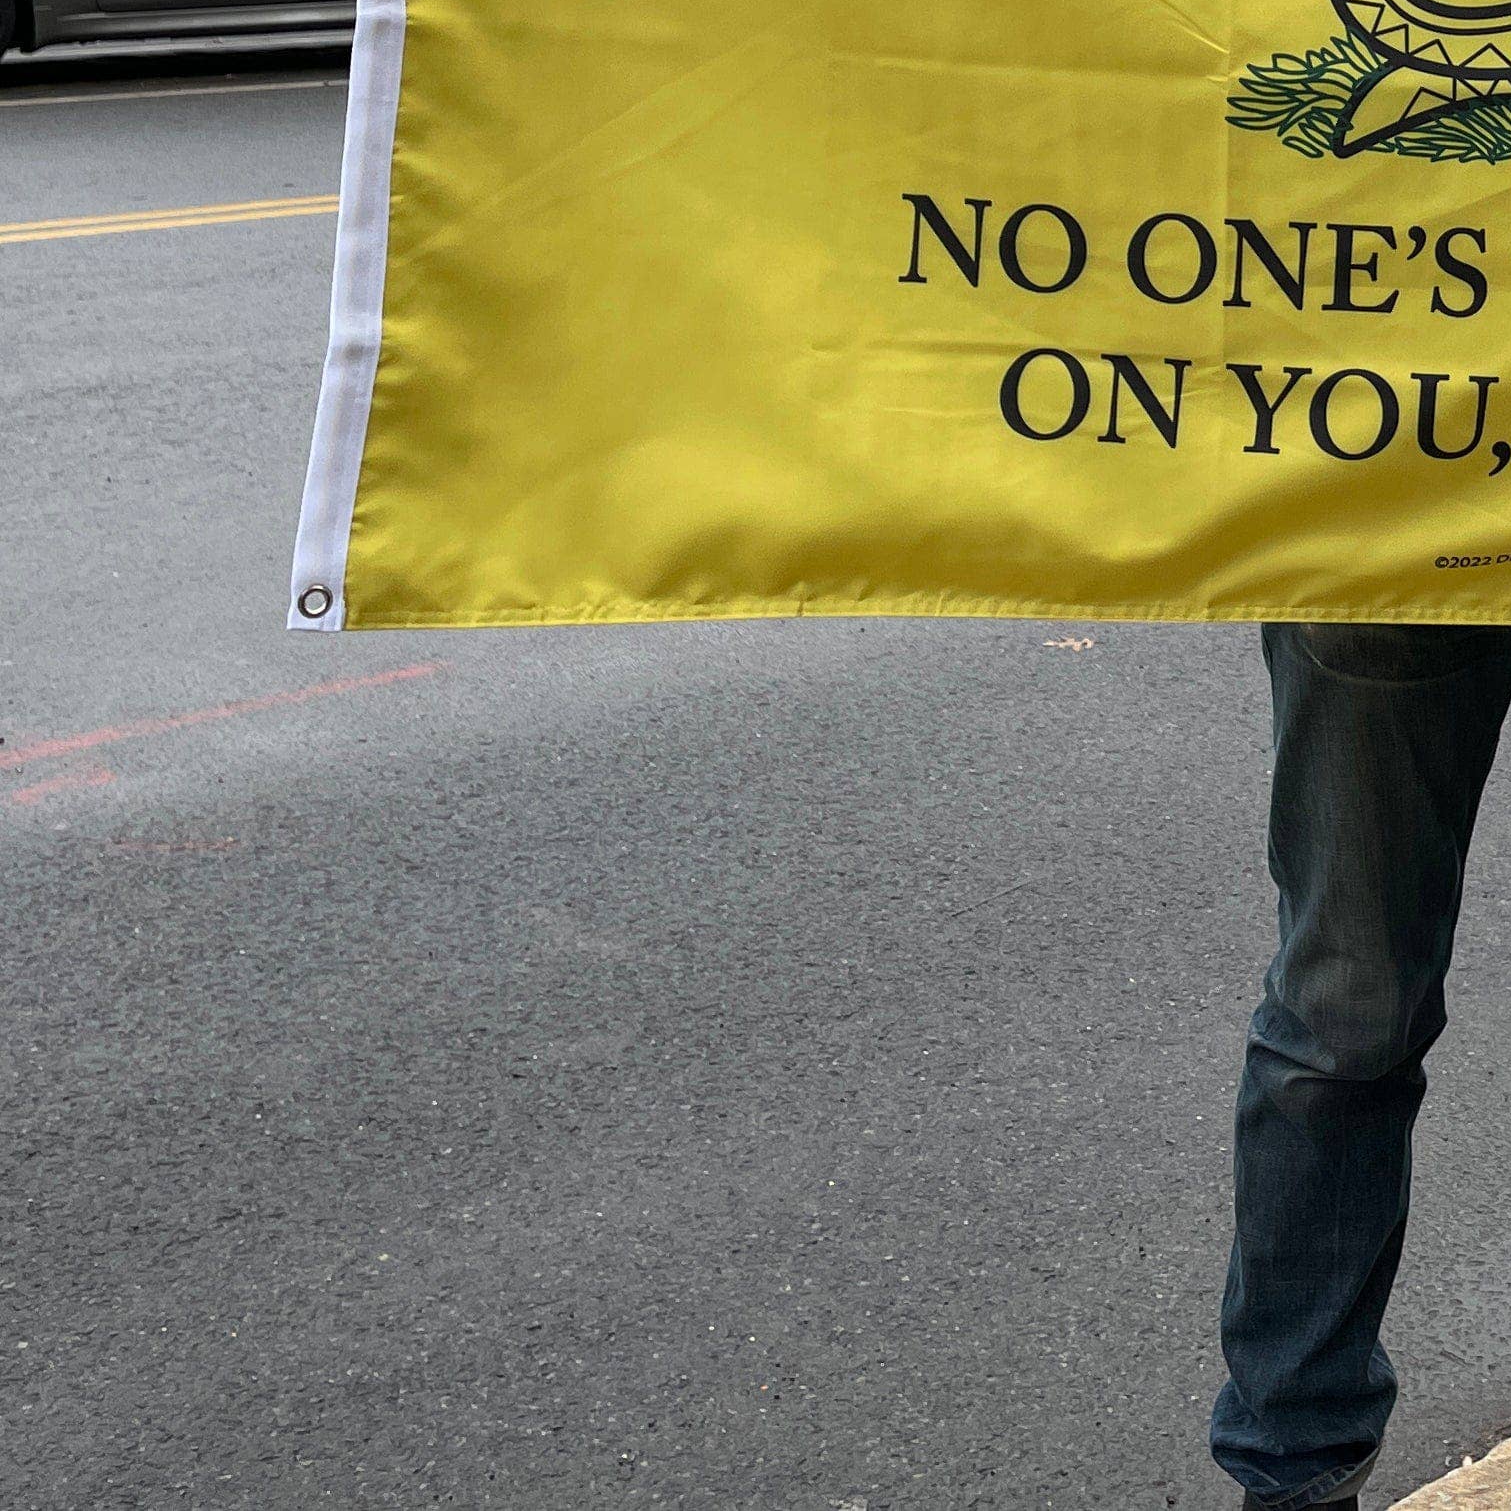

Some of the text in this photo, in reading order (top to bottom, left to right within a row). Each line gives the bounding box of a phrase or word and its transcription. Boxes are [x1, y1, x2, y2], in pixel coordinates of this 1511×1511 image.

[899, 193, 1087, 294] NO
[1127, 213, 1488, 318] ONE’S
[999, 348, 1193, 449] ON
[1225, 363, 1511, 477] YOU,
[1434, 556, 1492, 569] ©2022
